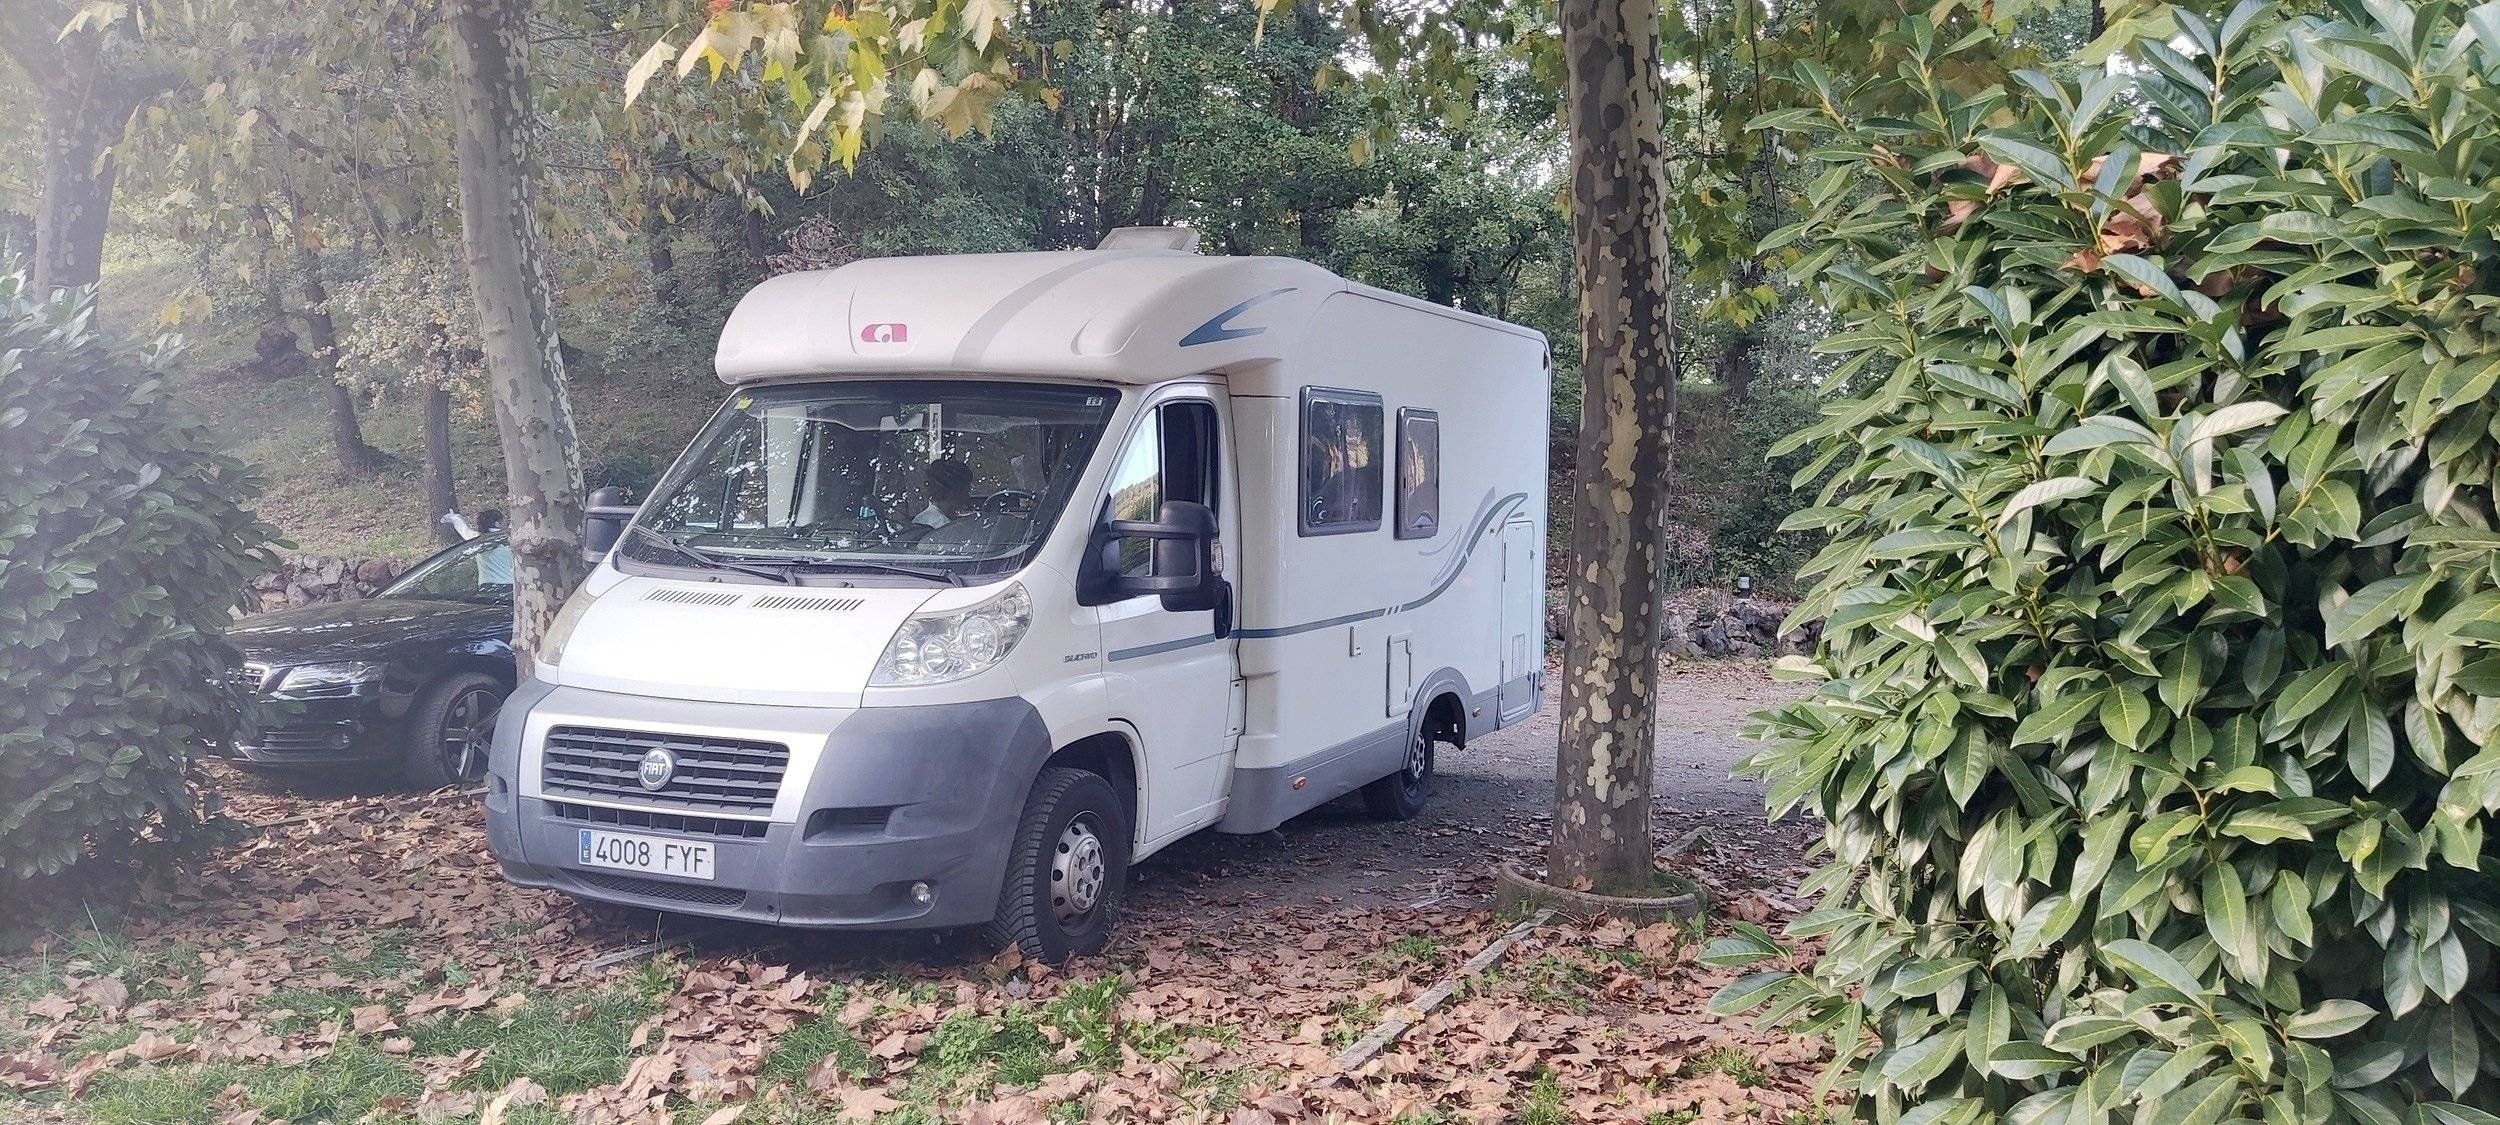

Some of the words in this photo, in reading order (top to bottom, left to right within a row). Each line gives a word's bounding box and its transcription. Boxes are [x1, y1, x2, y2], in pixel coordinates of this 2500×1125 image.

[643, 761, 666, 776] FIAT
[582, 850, 589, 858] E
[596, 837, 650, 867] 4008
[664, 844, 708, 873] FYF
